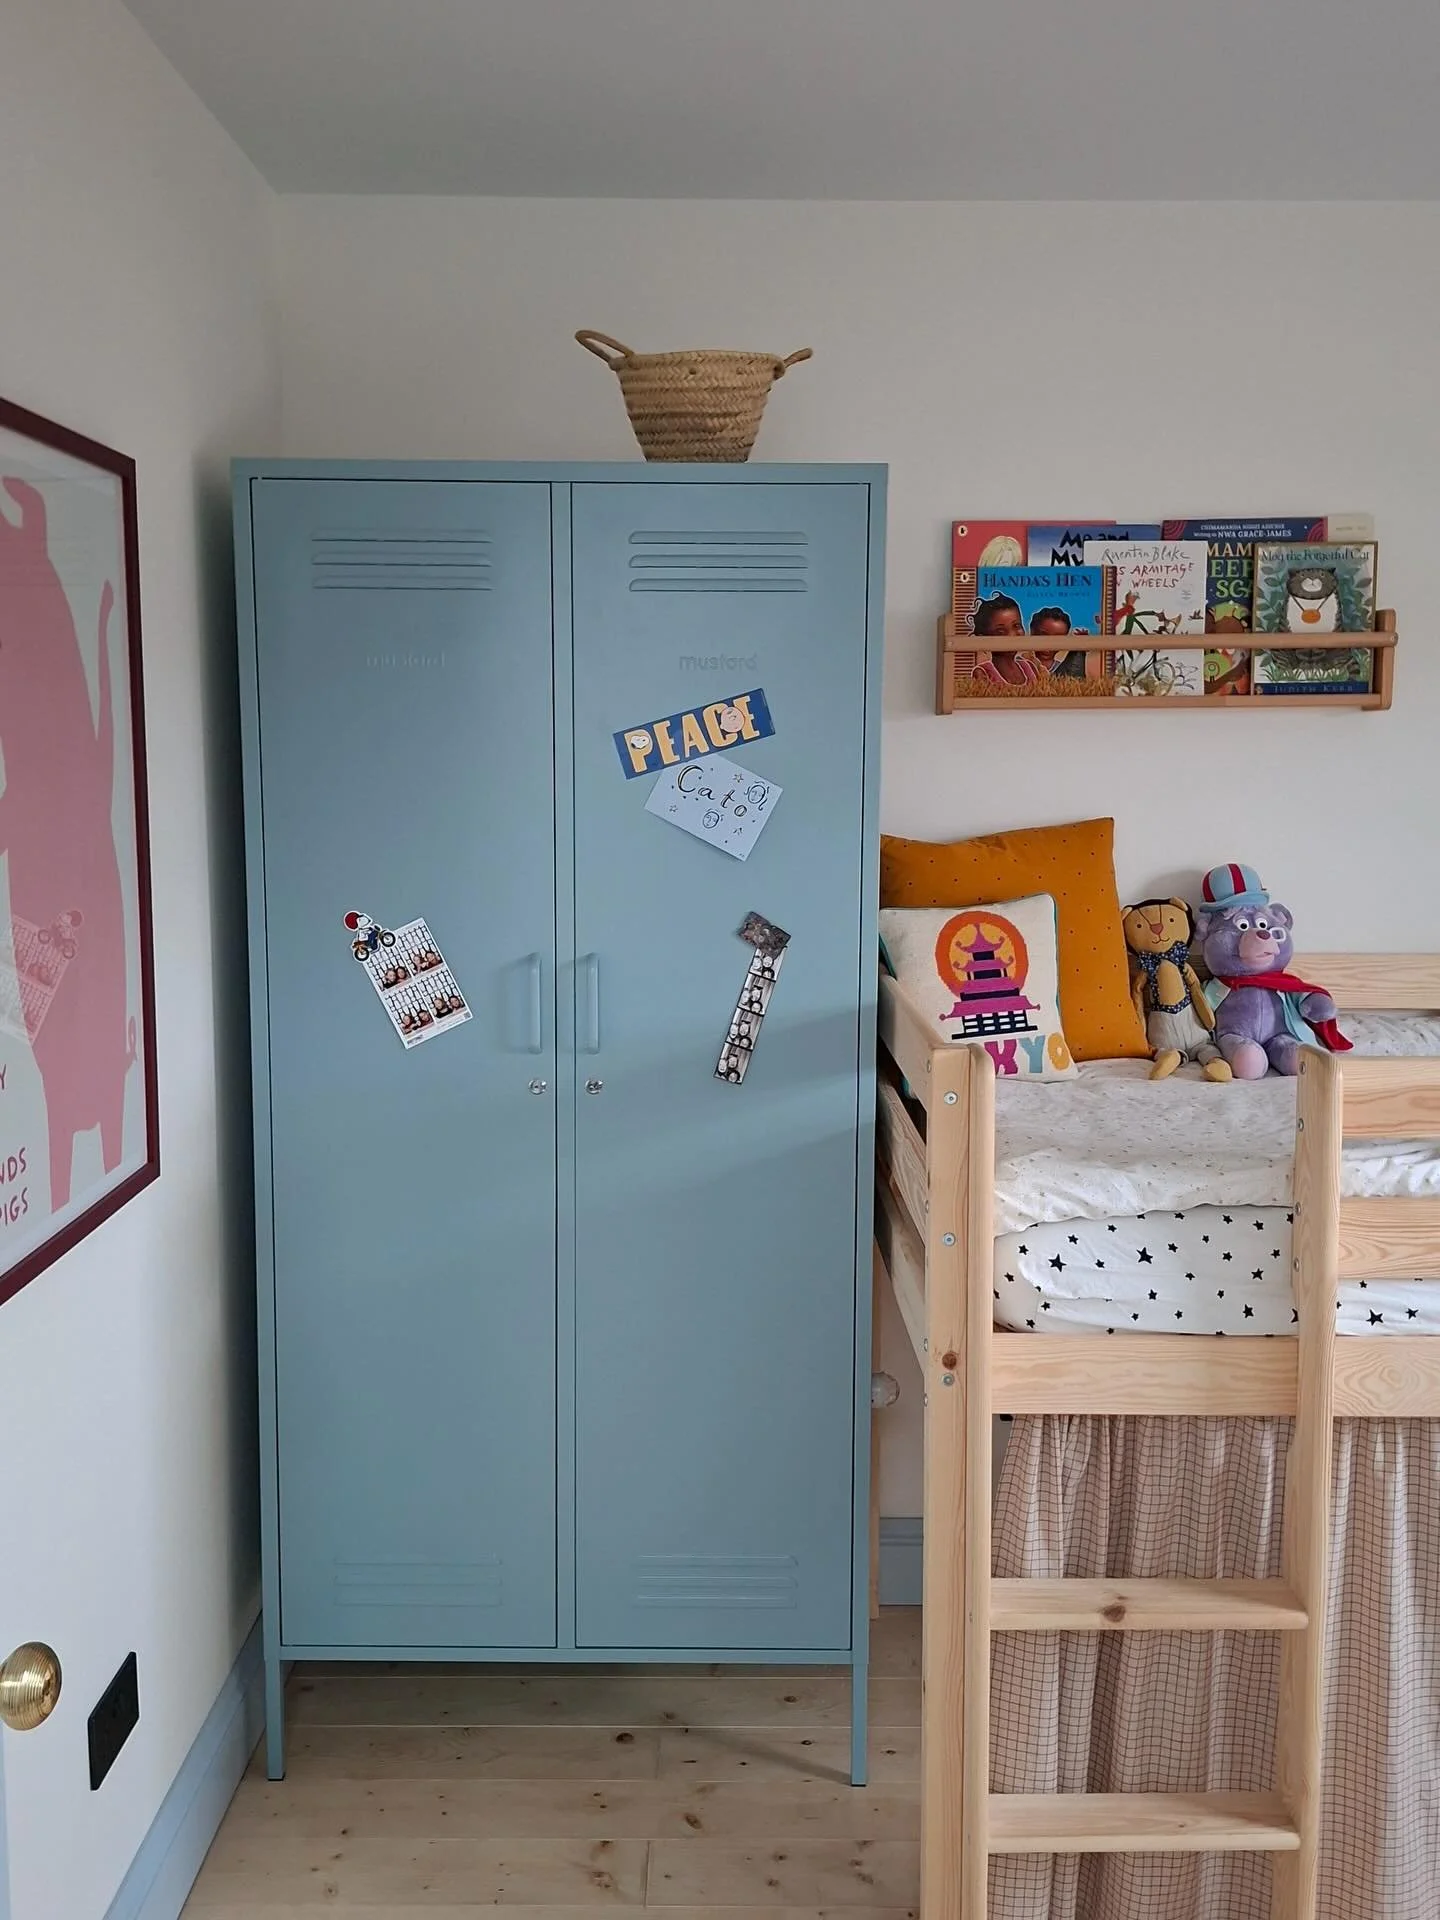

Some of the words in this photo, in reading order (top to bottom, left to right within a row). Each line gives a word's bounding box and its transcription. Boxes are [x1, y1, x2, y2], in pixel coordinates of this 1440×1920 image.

[1217, 531, 1237, 539] NWA
[1150, 545, 1191, 562] Blake
[1286, 549, 1301, 560] the
[1303, 548, 1348, 561] Forgetful
[1350, 548, 1370, 560] Cat
[1130, 562, 1195, 579] ARMITAGE
[983, 573, 1050, 588] HANDA'S
[1055, 572, 1092, 587] HEN
[1131, 578, 1179, 589] WHEELS
[679, 653, 758, 671] mustard
[624, 695, 760, 773] PEACE
[677, 764, 748, 818] Cato
[0, 1187, 29, 1227] IGS
